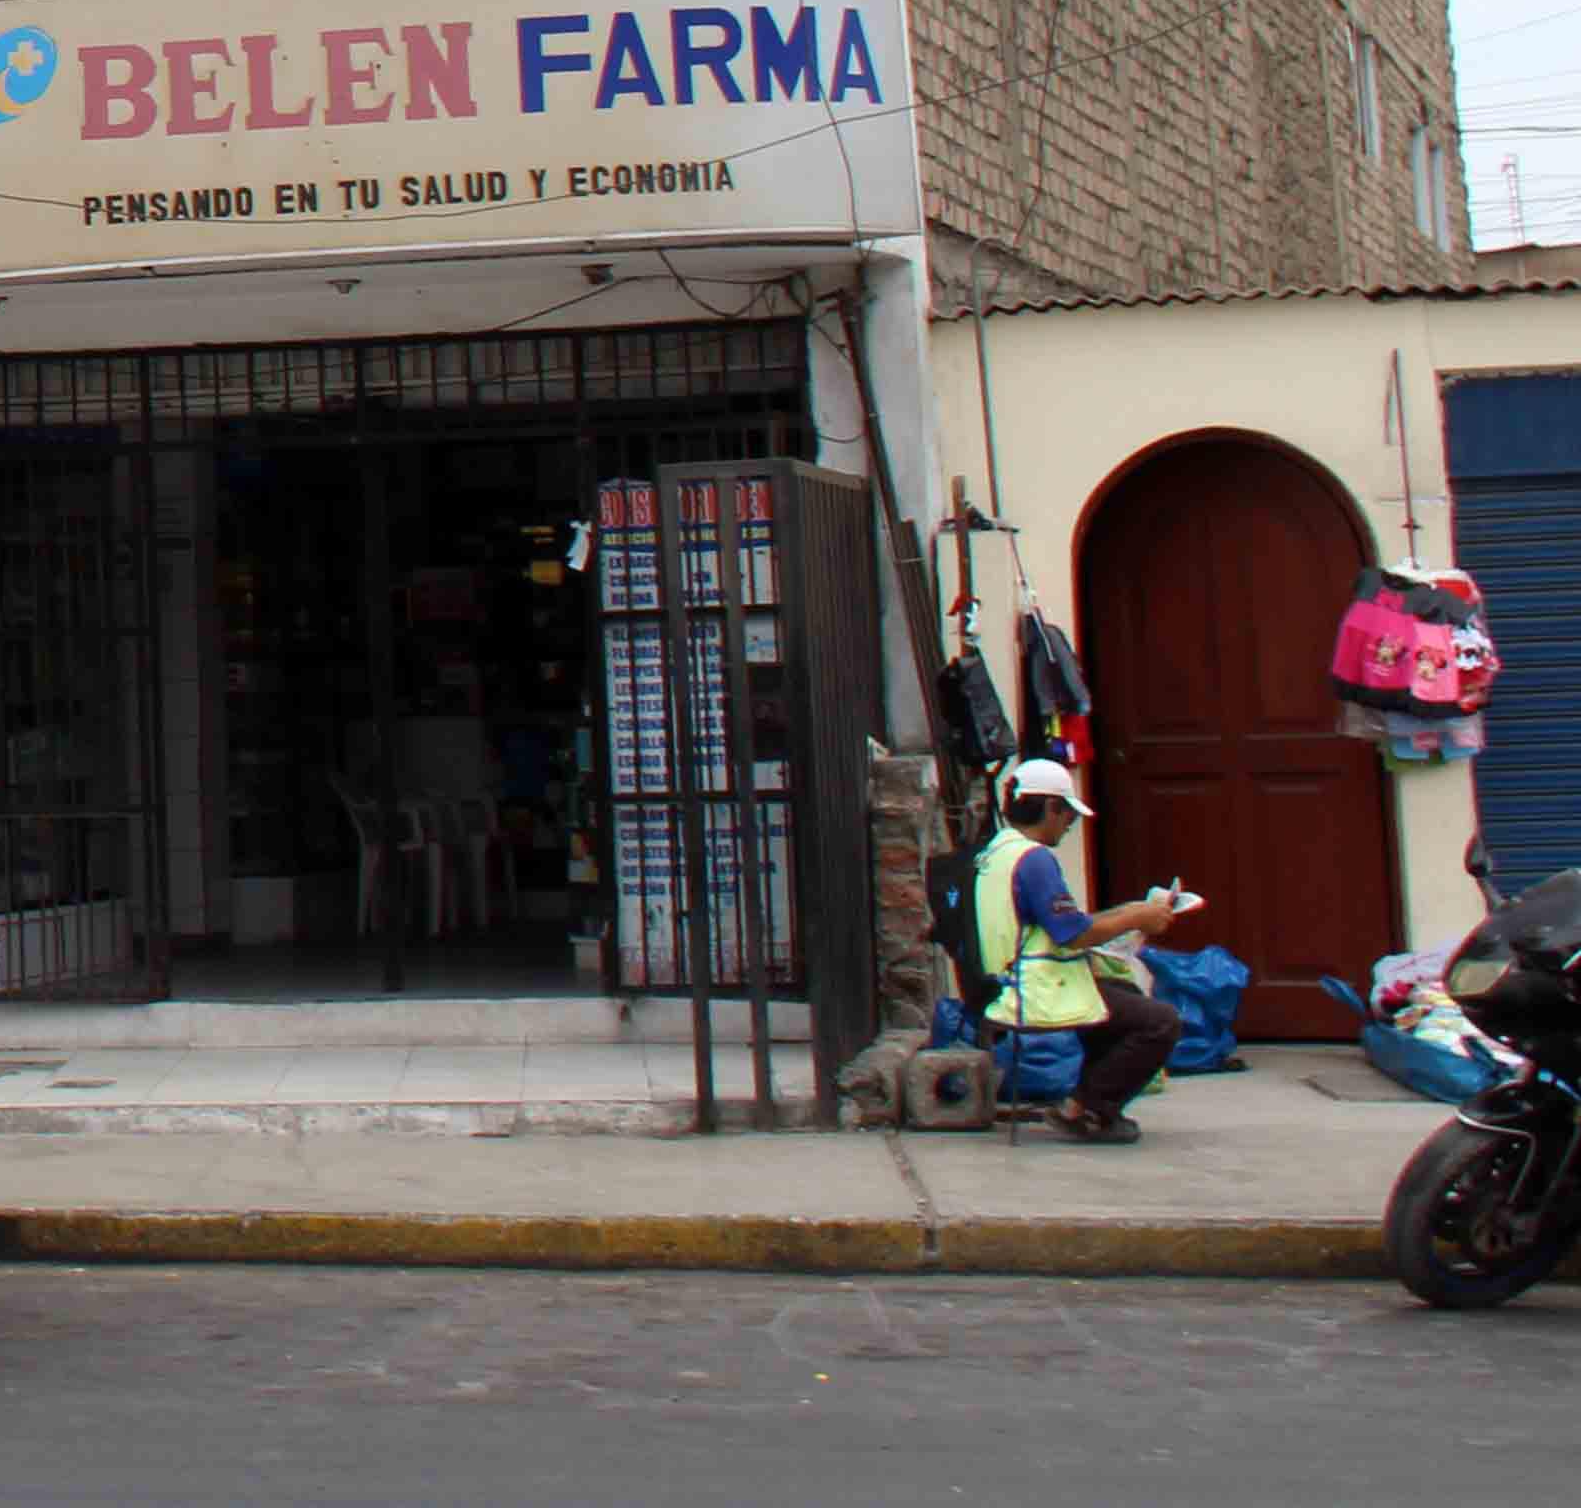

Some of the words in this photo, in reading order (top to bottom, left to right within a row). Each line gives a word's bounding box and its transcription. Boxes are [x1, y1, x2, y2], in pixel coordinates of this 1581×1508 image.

[78, 21, 477, 142] BELEN
[515, 4, 884, 114] FARMA
[82, 186, 254, 227] PENSANDO
[273, 182, 318, 216] EN
[337, 179, 380, 213] TU
[401, 171, 508, 208] SALUD
[528, 168, 547, 200] Y
[568, 160, 735, 198] ECONOMIA
